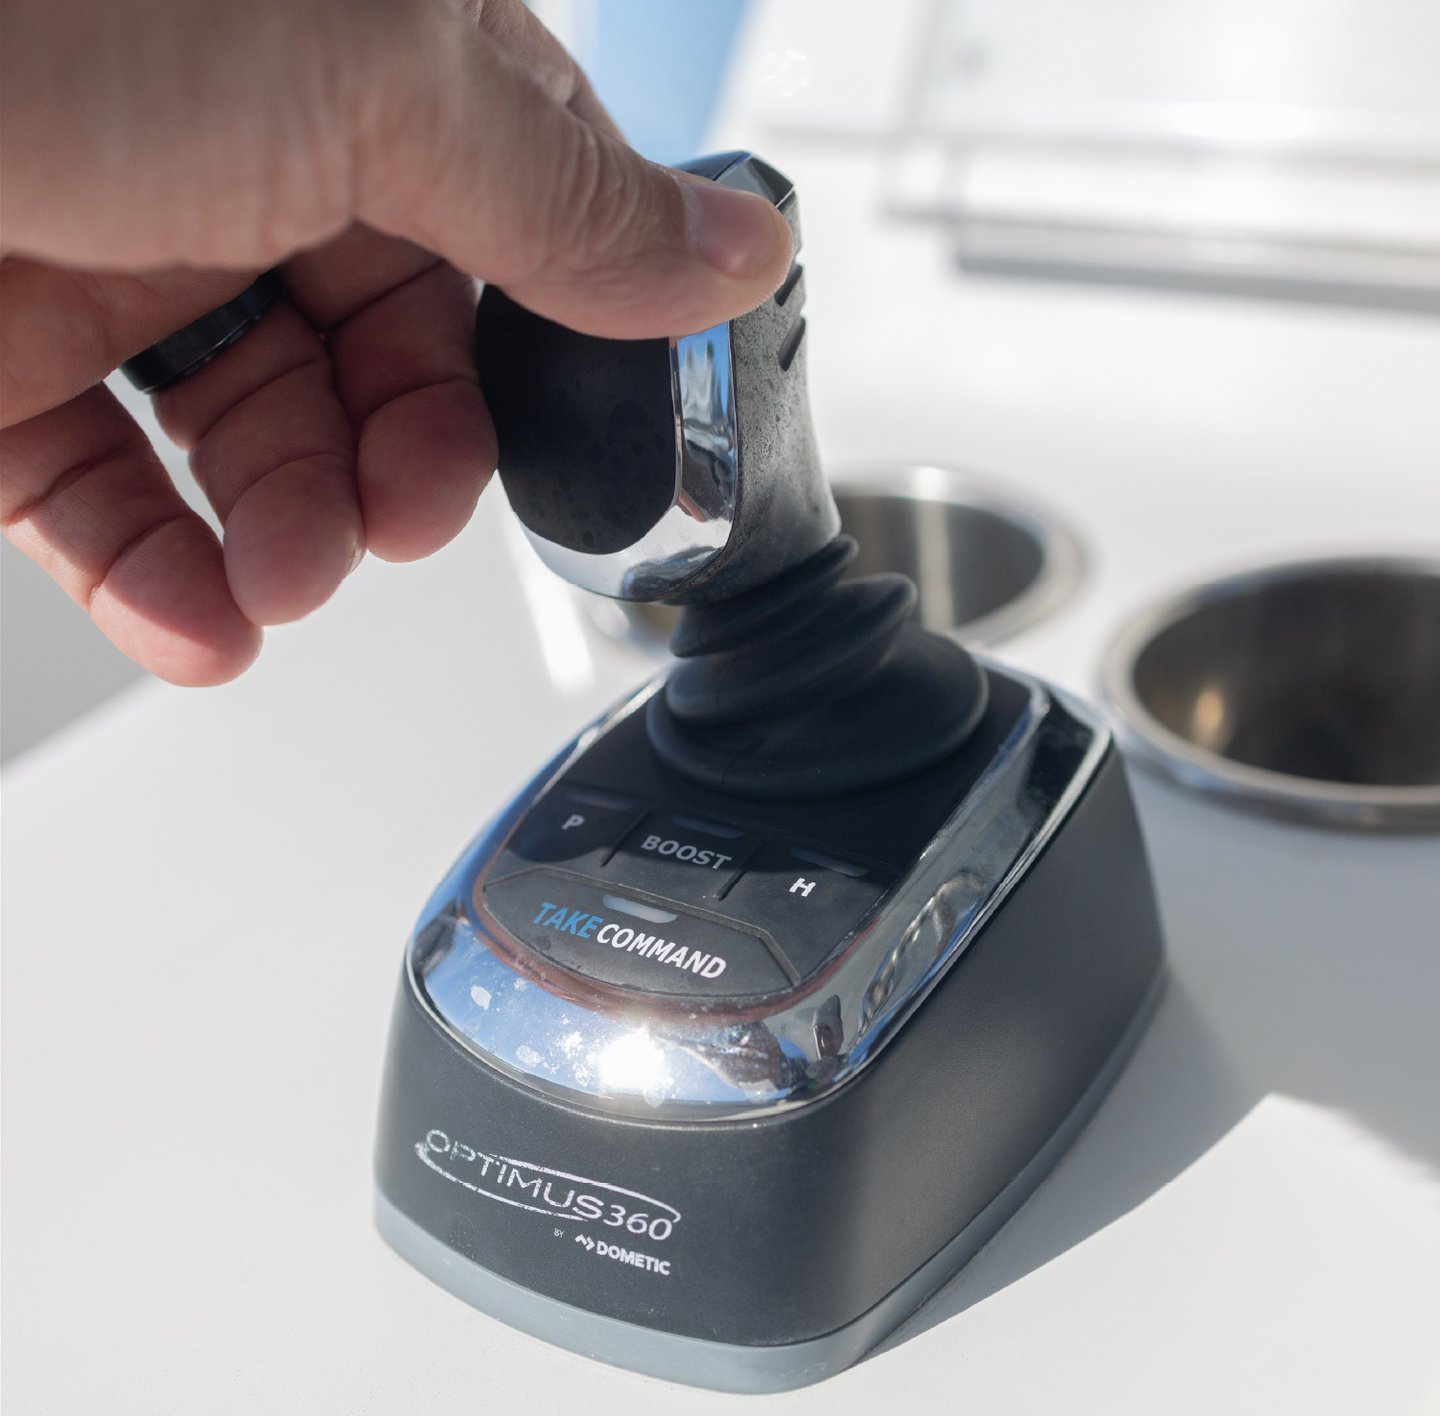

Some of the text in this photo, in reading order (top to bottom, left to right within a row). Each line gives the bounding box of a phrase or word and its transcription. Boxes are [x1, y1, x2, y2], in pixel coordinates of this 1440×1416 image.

[561, 813, 585, 832] P
[640, 835, 732, 871] BOOST
[789, 877, 816, 898] H
[553, 1227, 671, 1276] BY DOMETIC
